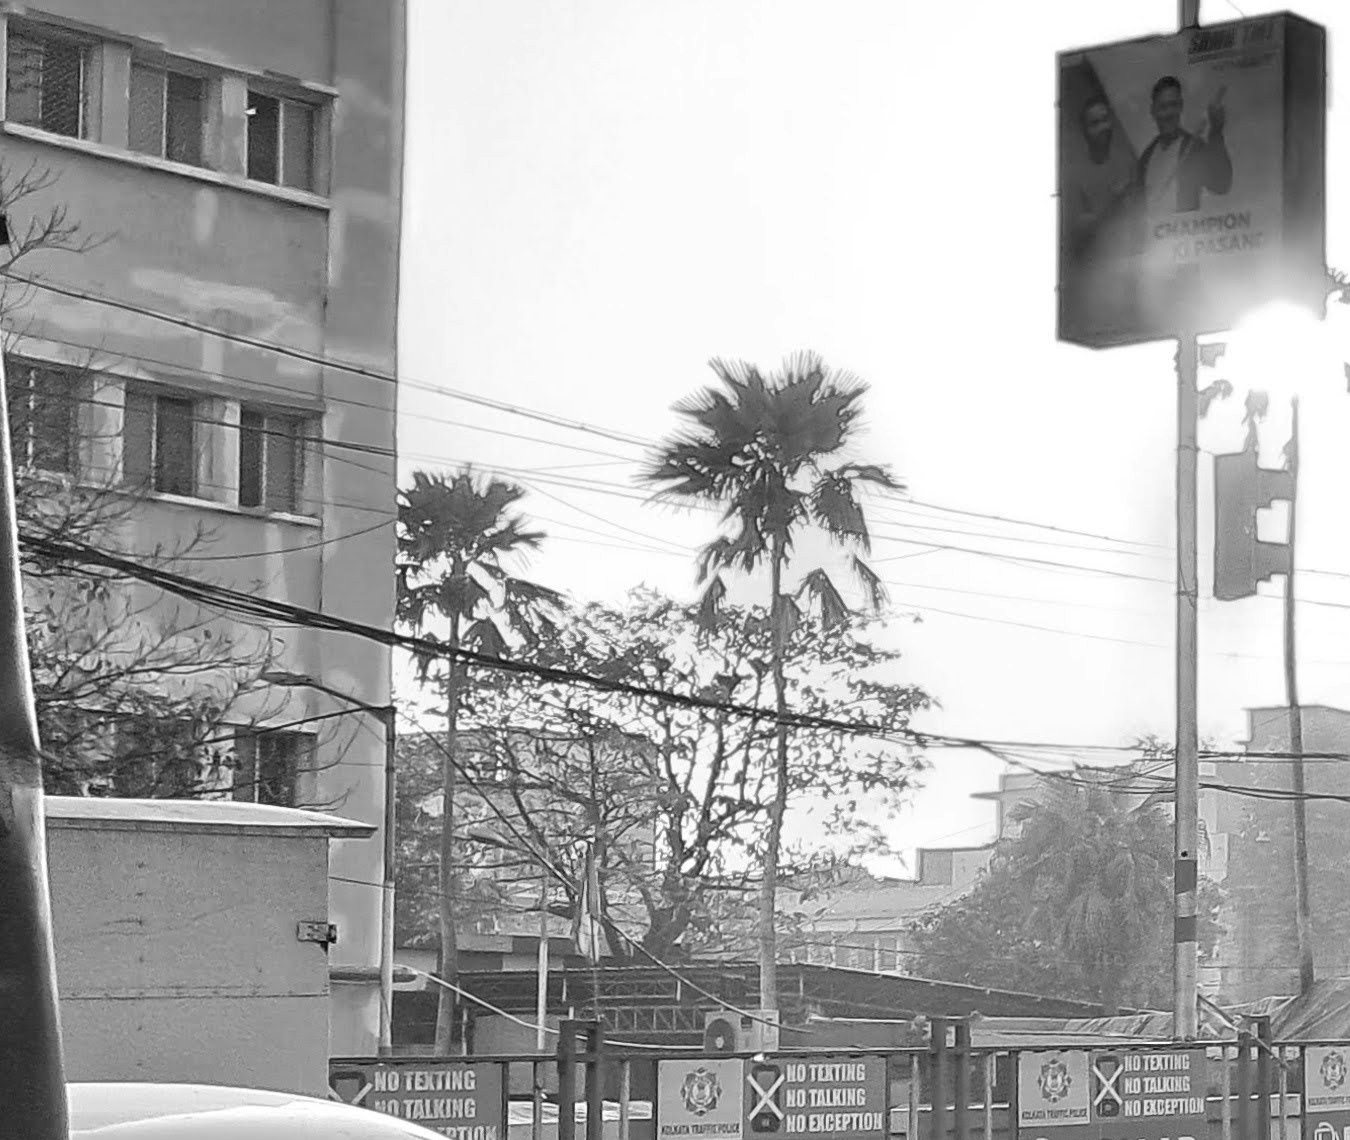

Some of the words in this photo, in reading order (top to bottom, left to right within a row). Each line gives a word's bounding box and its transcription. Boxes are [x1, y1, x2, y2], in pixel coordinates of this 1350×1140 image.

[786, 1064, 806, 1082] NO
[810, 1063, 866, 1082] TEXTING
[1124, 1055, 1140, 1072] NO
[1143, 1054, 1190, 1071] TEXTING
[374, 1071, 399, 1091] NO
[403, 1070, 476, 1091] TEXTING
[1124, 1077, 1140, 1094] NO
[1143, 1076, 1190, 1094] TALKING
[786, 1089, 806, 1107] NO
[810, 1088, 866, 1107] TALKING
[1124, 1099, 1140, 1117] NO
[1143, 1097, 1205, 1116] EXCEPTION
[404, 1098, 476, 1119] TALKING
[786, 1114, 806, 1133] NO
[809, 1112, 883, 1132] EXCEPTION
